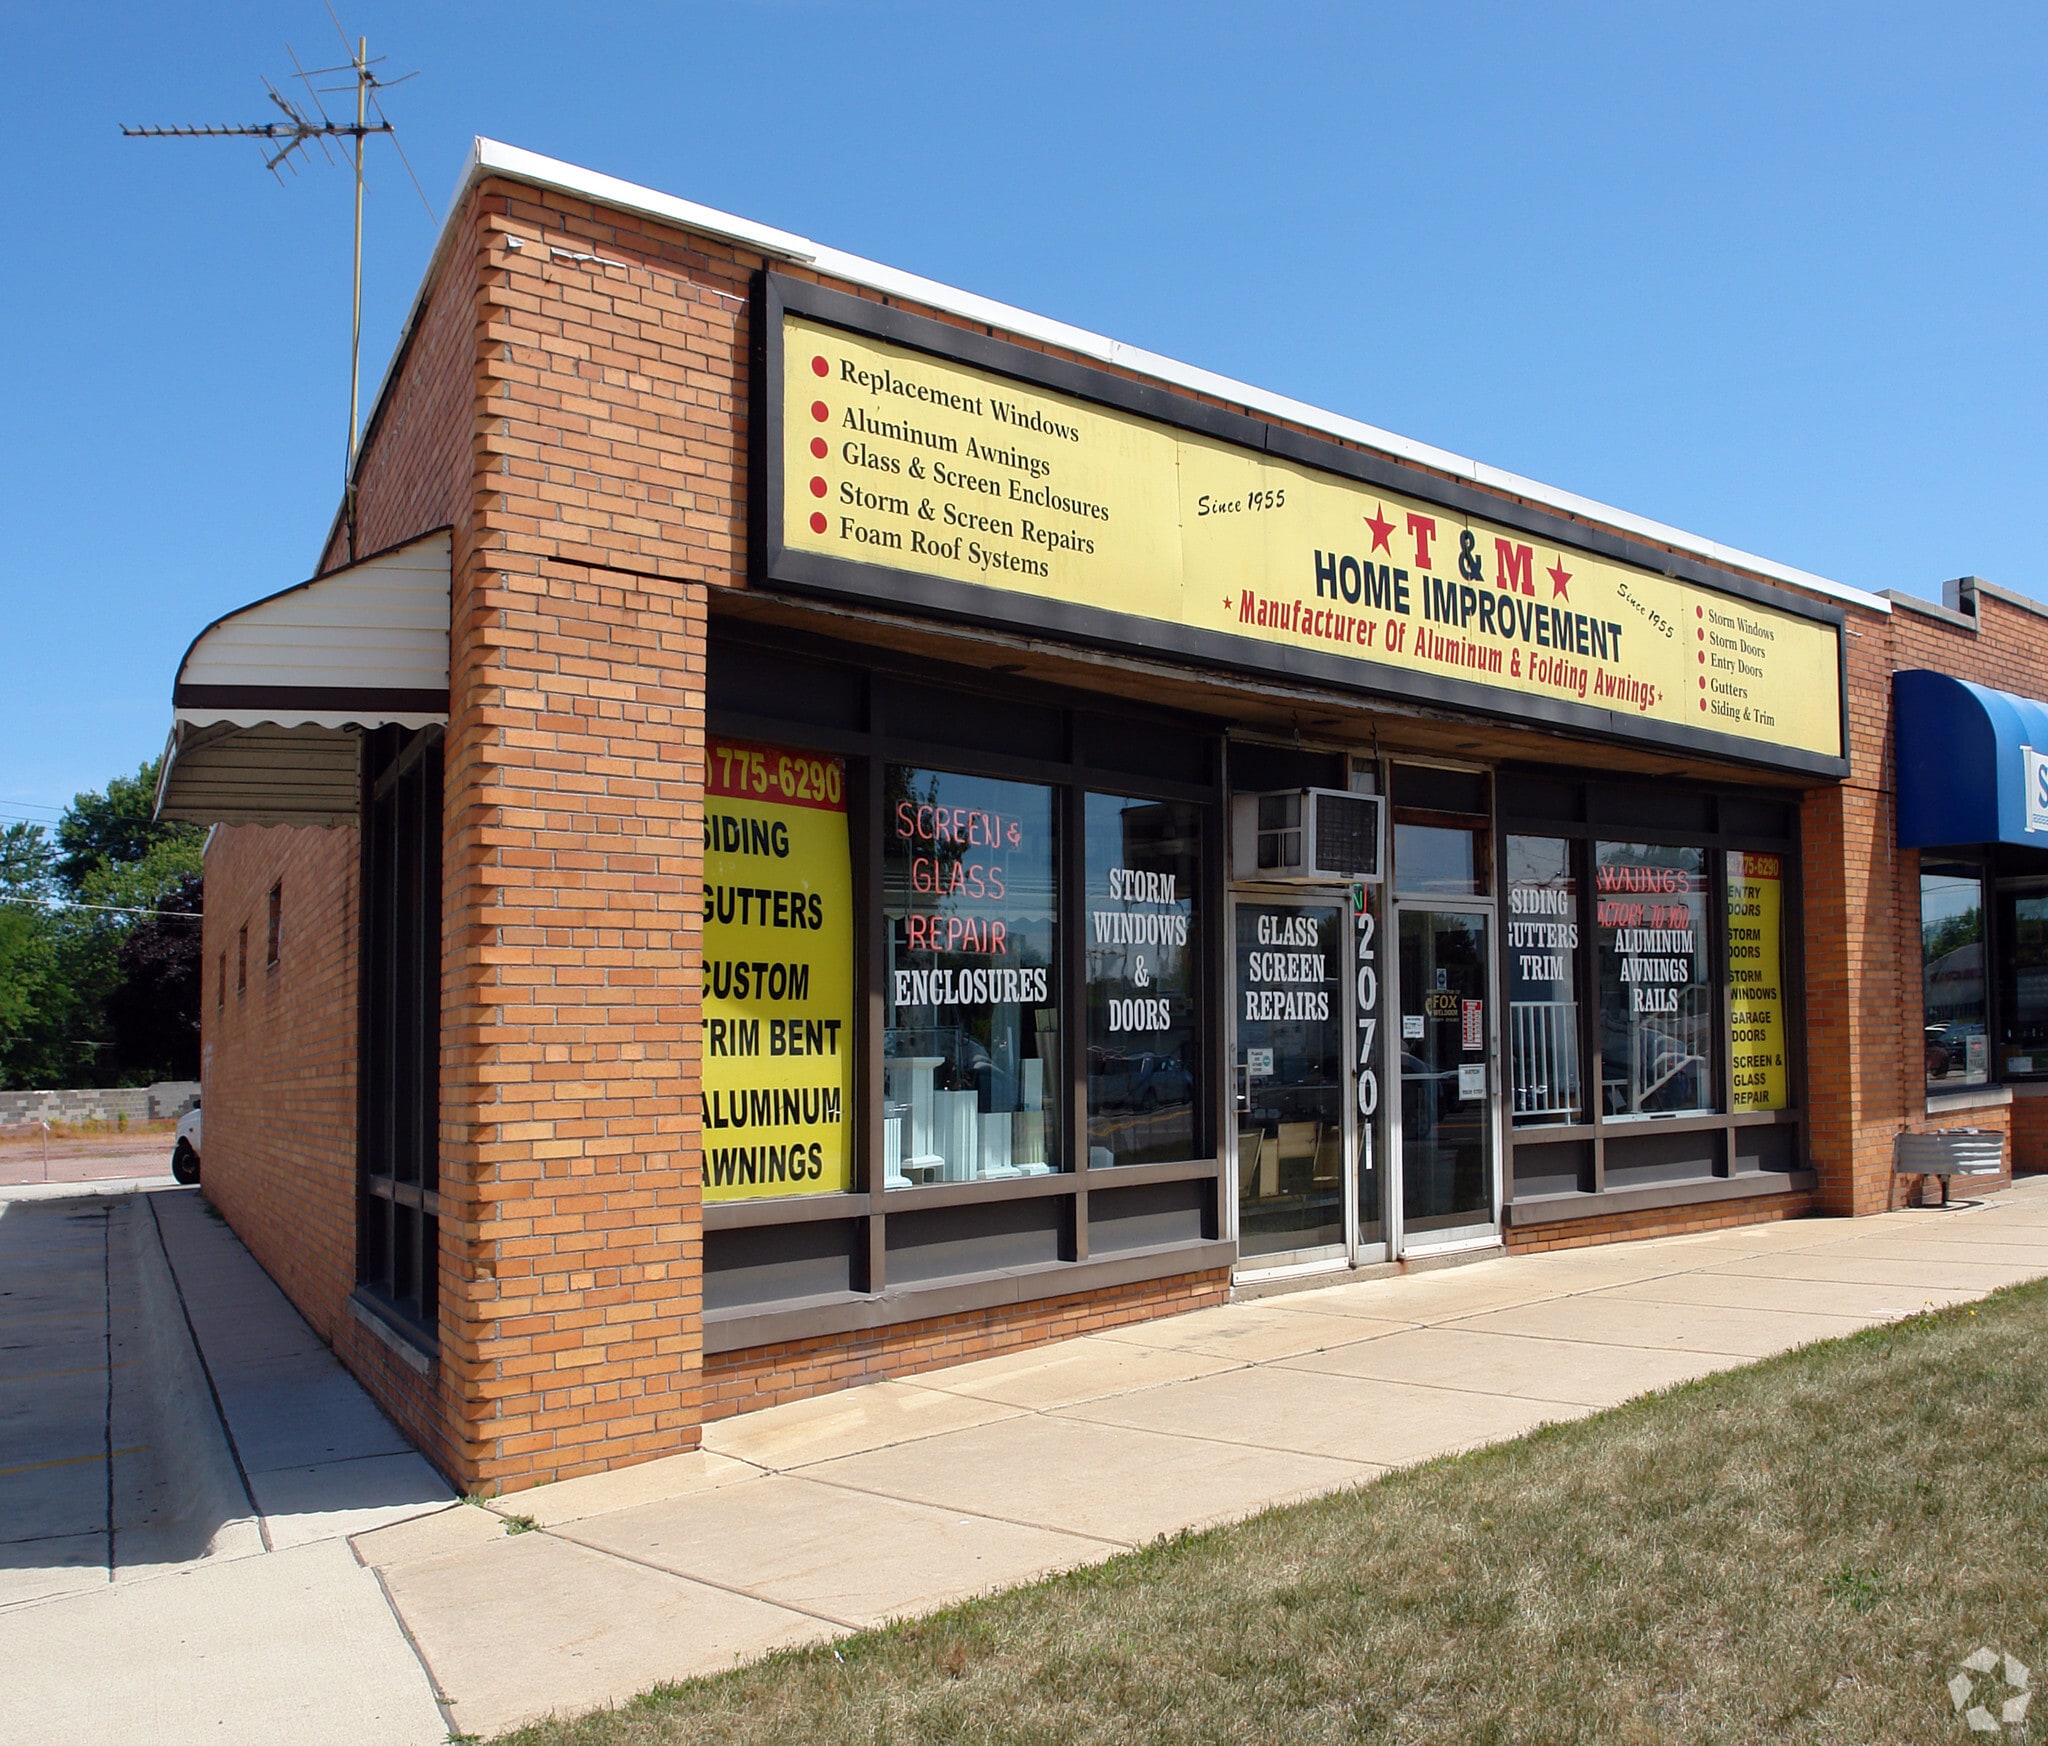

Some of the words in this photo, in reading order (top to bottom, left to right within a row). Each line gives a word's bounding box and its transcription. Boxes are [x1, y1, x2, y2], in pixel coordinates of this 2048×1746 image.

[839, 359, 983, 416] Replacement
[990, 398, 1079, 442] Windows
[841, 407, 958, 453] Aluminum
[966, 437, 1050, 479] Awnings
[842, 442, 900, 474] Glass
[909, 457, 925, 480] &
[934, 462, 1000, 496] Screen
[1009, 478, 1109, 521] Enclosures
[840, 482, 909, 516] Storm
[917, 498, 935, 521] &
[943, 503, 1013, 538] Screen
[1021, 519, 1095, 555] Repairs
[1198, 495, 1241, 516] Since
[1248, 489, 1285, 512] 1955
[839, 517, 902, 549] Foam
[911, 530, 963, 561] Roof
[968, 542, 1049, 578] Systems
[1407, 512, 1436, 570] T
[1458, 529, 1485, 582] &
[1494, 537, 1535, 597] M
[1314, 549, 1410, 615] HOME
[1423, 575, 1622, 663] IMPROVEMENT
[1617, 583, 1646, 615] Since
[1648, 610, 1674, 638] 1955
[1708, 609, 1735, 628] Storm
[1737, 617, 1775, 641] Windows
[1239, 589, 1376, 647] Manufacturer
[1385, 619, 1406, 653] Of
[1414, 626, 1502, 673] Aluminum
[1510, 648, 1521, 677] &
[1529, 651, 1588, 698] Folding
[1594, 667, 1655, 711] Awnings
[1710, 632, 1737, 650] Storm
[1740, 639, 1766, 658] Doors
[1711, 653, 1736, 675] Entry
[1738, 659, 1763, 678] Doors
[1711, 678, 1748, 699] Gutters
[1711, 701, 1741, 723] Siding
[1743, 707, 1751, 721] &
[1753, 709, 1775, 727] Trim
[717, 747, 841, 804] 775-6290
[897, 802, 1001, 849] SCREEN
[1006, 822, 1021, 847] &
[912, 857, 1005, 899] GLASS
[1109, 867, 1175, 905] STORM
[1728, 885, 1760, 899] ENTRY
[1511, 888, 1568, 915] SIDING
[908, 914, 1007, 955] REPAIR
[1093, 911, 1187, 946] WINDOWS
[1257, 914, 1318, 947] GLASS
[1614, 929, 1694, 953] ALUMINUM
[1134, 955, 1149, 987] &
[1249, 951, 1326, 983] SCREEN
[1520, 955, 1564, 980] TRIM
[1620, 958, 1688, 982] AWNINGS
[894, 967, 1048, 1006] ENCLOSURES
[1433, 995, 1457, 1008] FOX
[1633, 988, 1678, 1013] RAILS
[1109, 998, 1171, 1031] DOORS
[1246, 990, 1329, 1021] REPAIRS
[1731, 1011, 1771, 1024] GARAGE
[770, 1018, 842, 1056] BENT
[1358, 913, 1378, 1170] 20701
[1732, 1029, 1766, 1042] DOORS
[1733, 1055, 1772, 1068] SCREEN
[1775, 1054, 1782, 1066] &
[1734, 1073, 1766, 1086] GLASS
[1734, 1090, 1769, 1104] REPAIR
